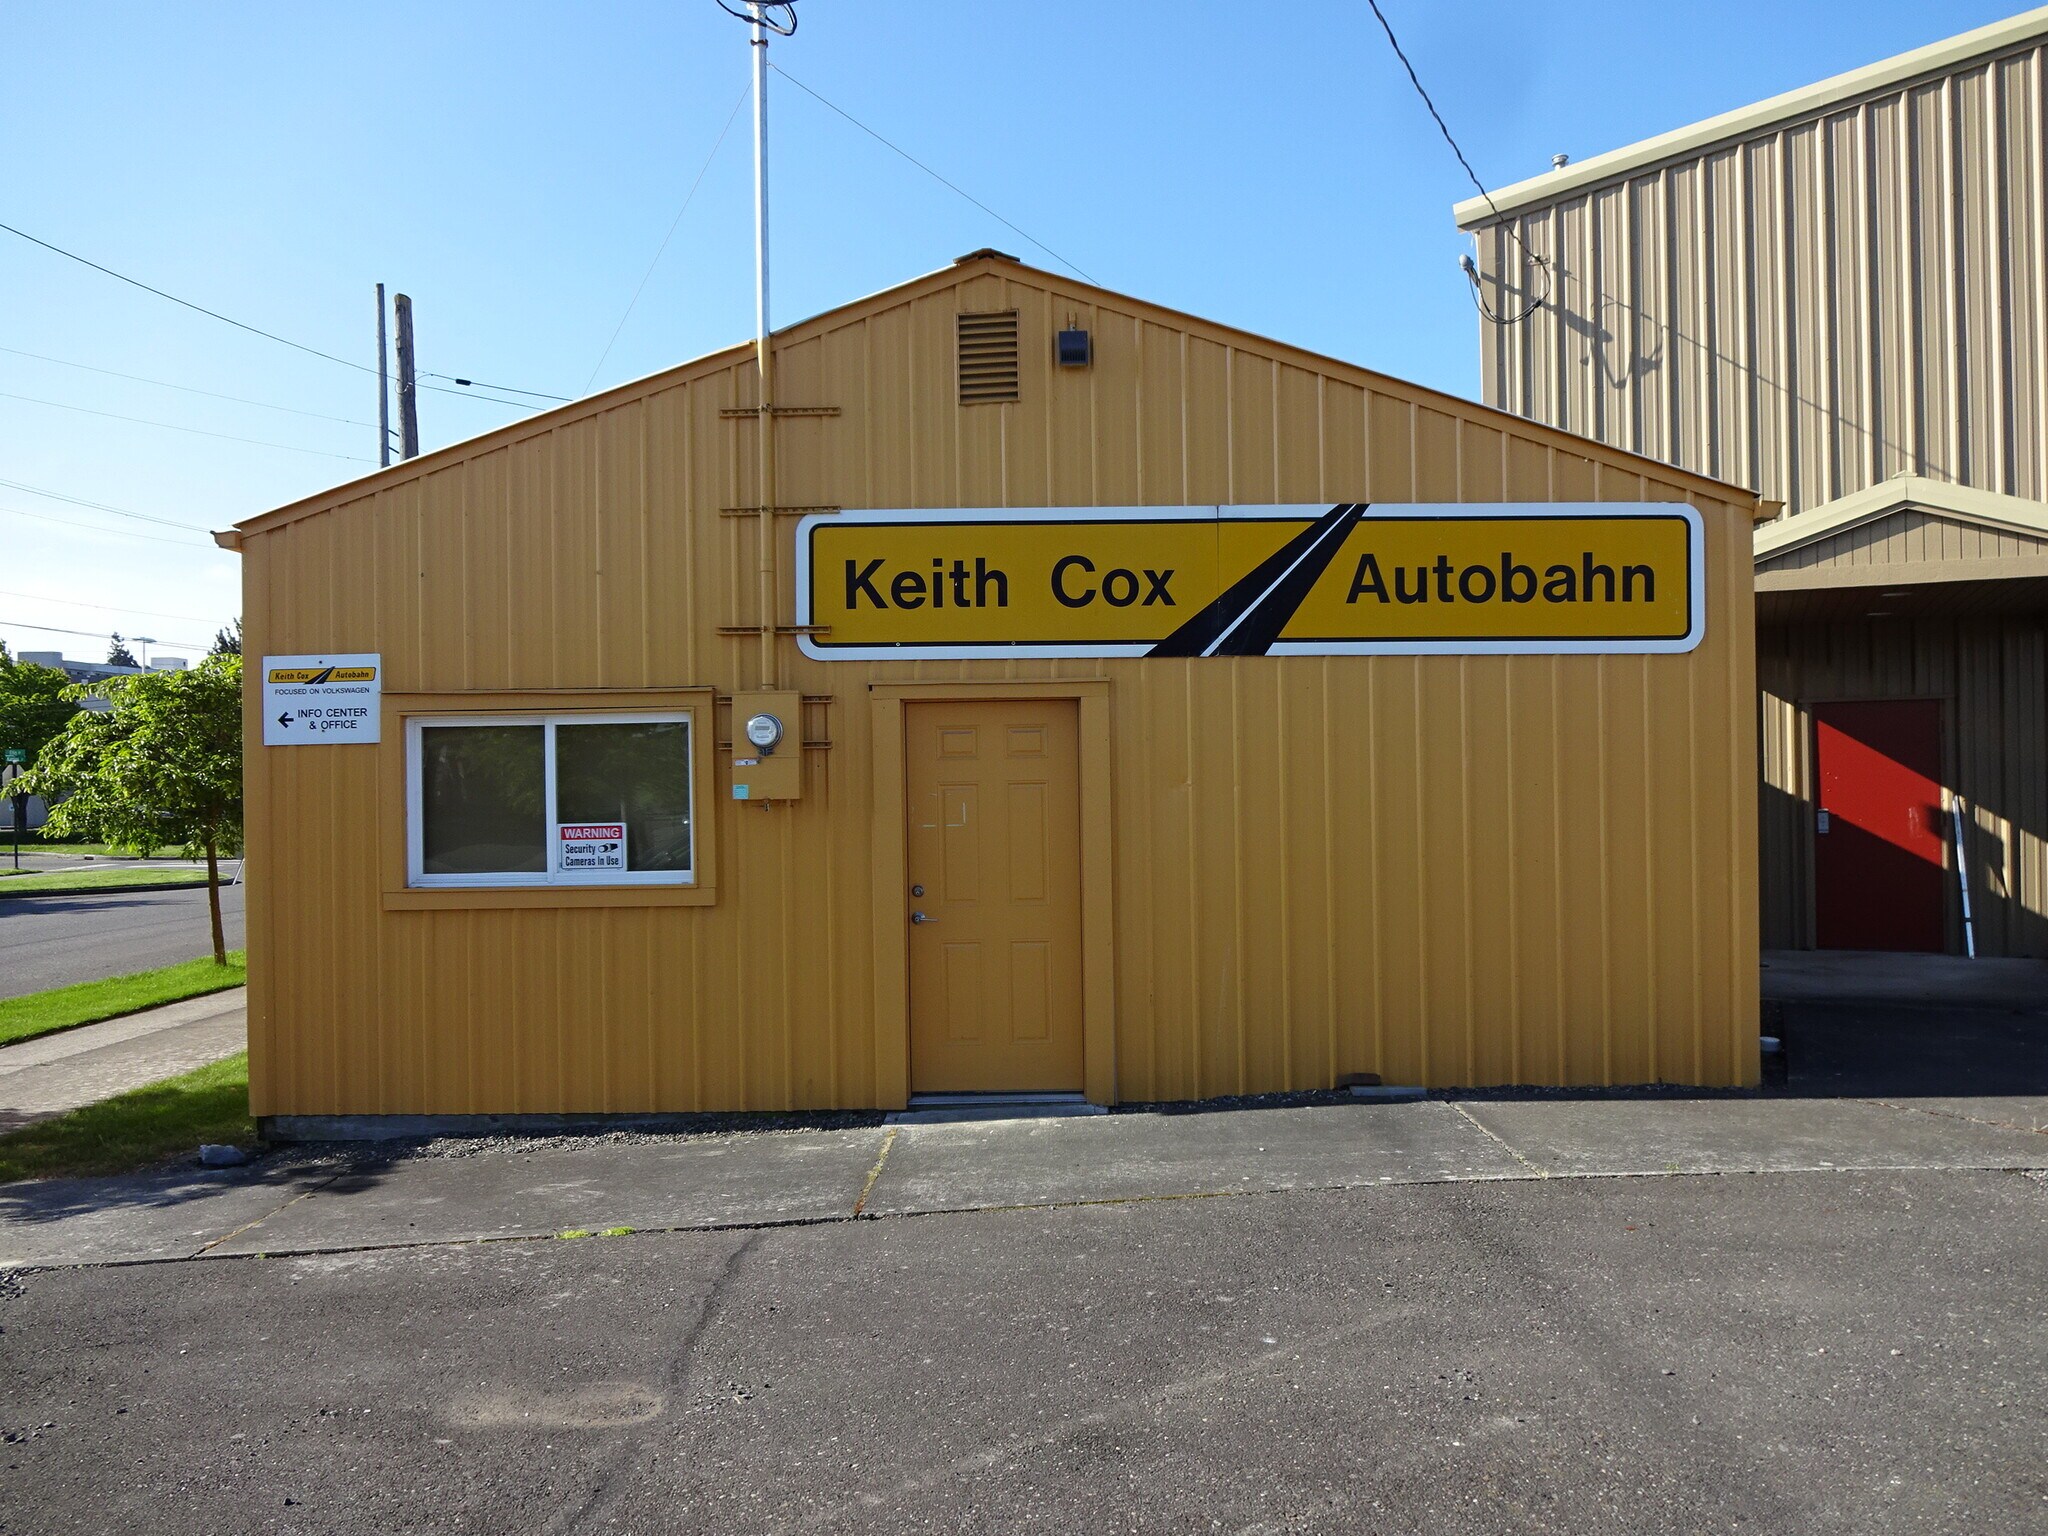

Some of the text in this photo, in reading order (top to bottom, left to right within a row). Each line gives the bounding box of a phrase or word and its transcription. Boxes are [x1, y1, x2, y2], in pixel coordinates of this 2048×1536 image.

[845, 552, 1655, 609] Keith Cox Autobahn
[275, 670, 369, 680] Keith Cox Autobahn
[322, 687, 370, 695] VOLKSWAGEN
[297, 708, 368, 718] INFO CENTER
[309, 720, 358, 730] & OFFICE
[564, 828, 620, 839] WARNING
[565, 844, 596, 855] Security
[565, 855, 619, 867] Cameras In Use
